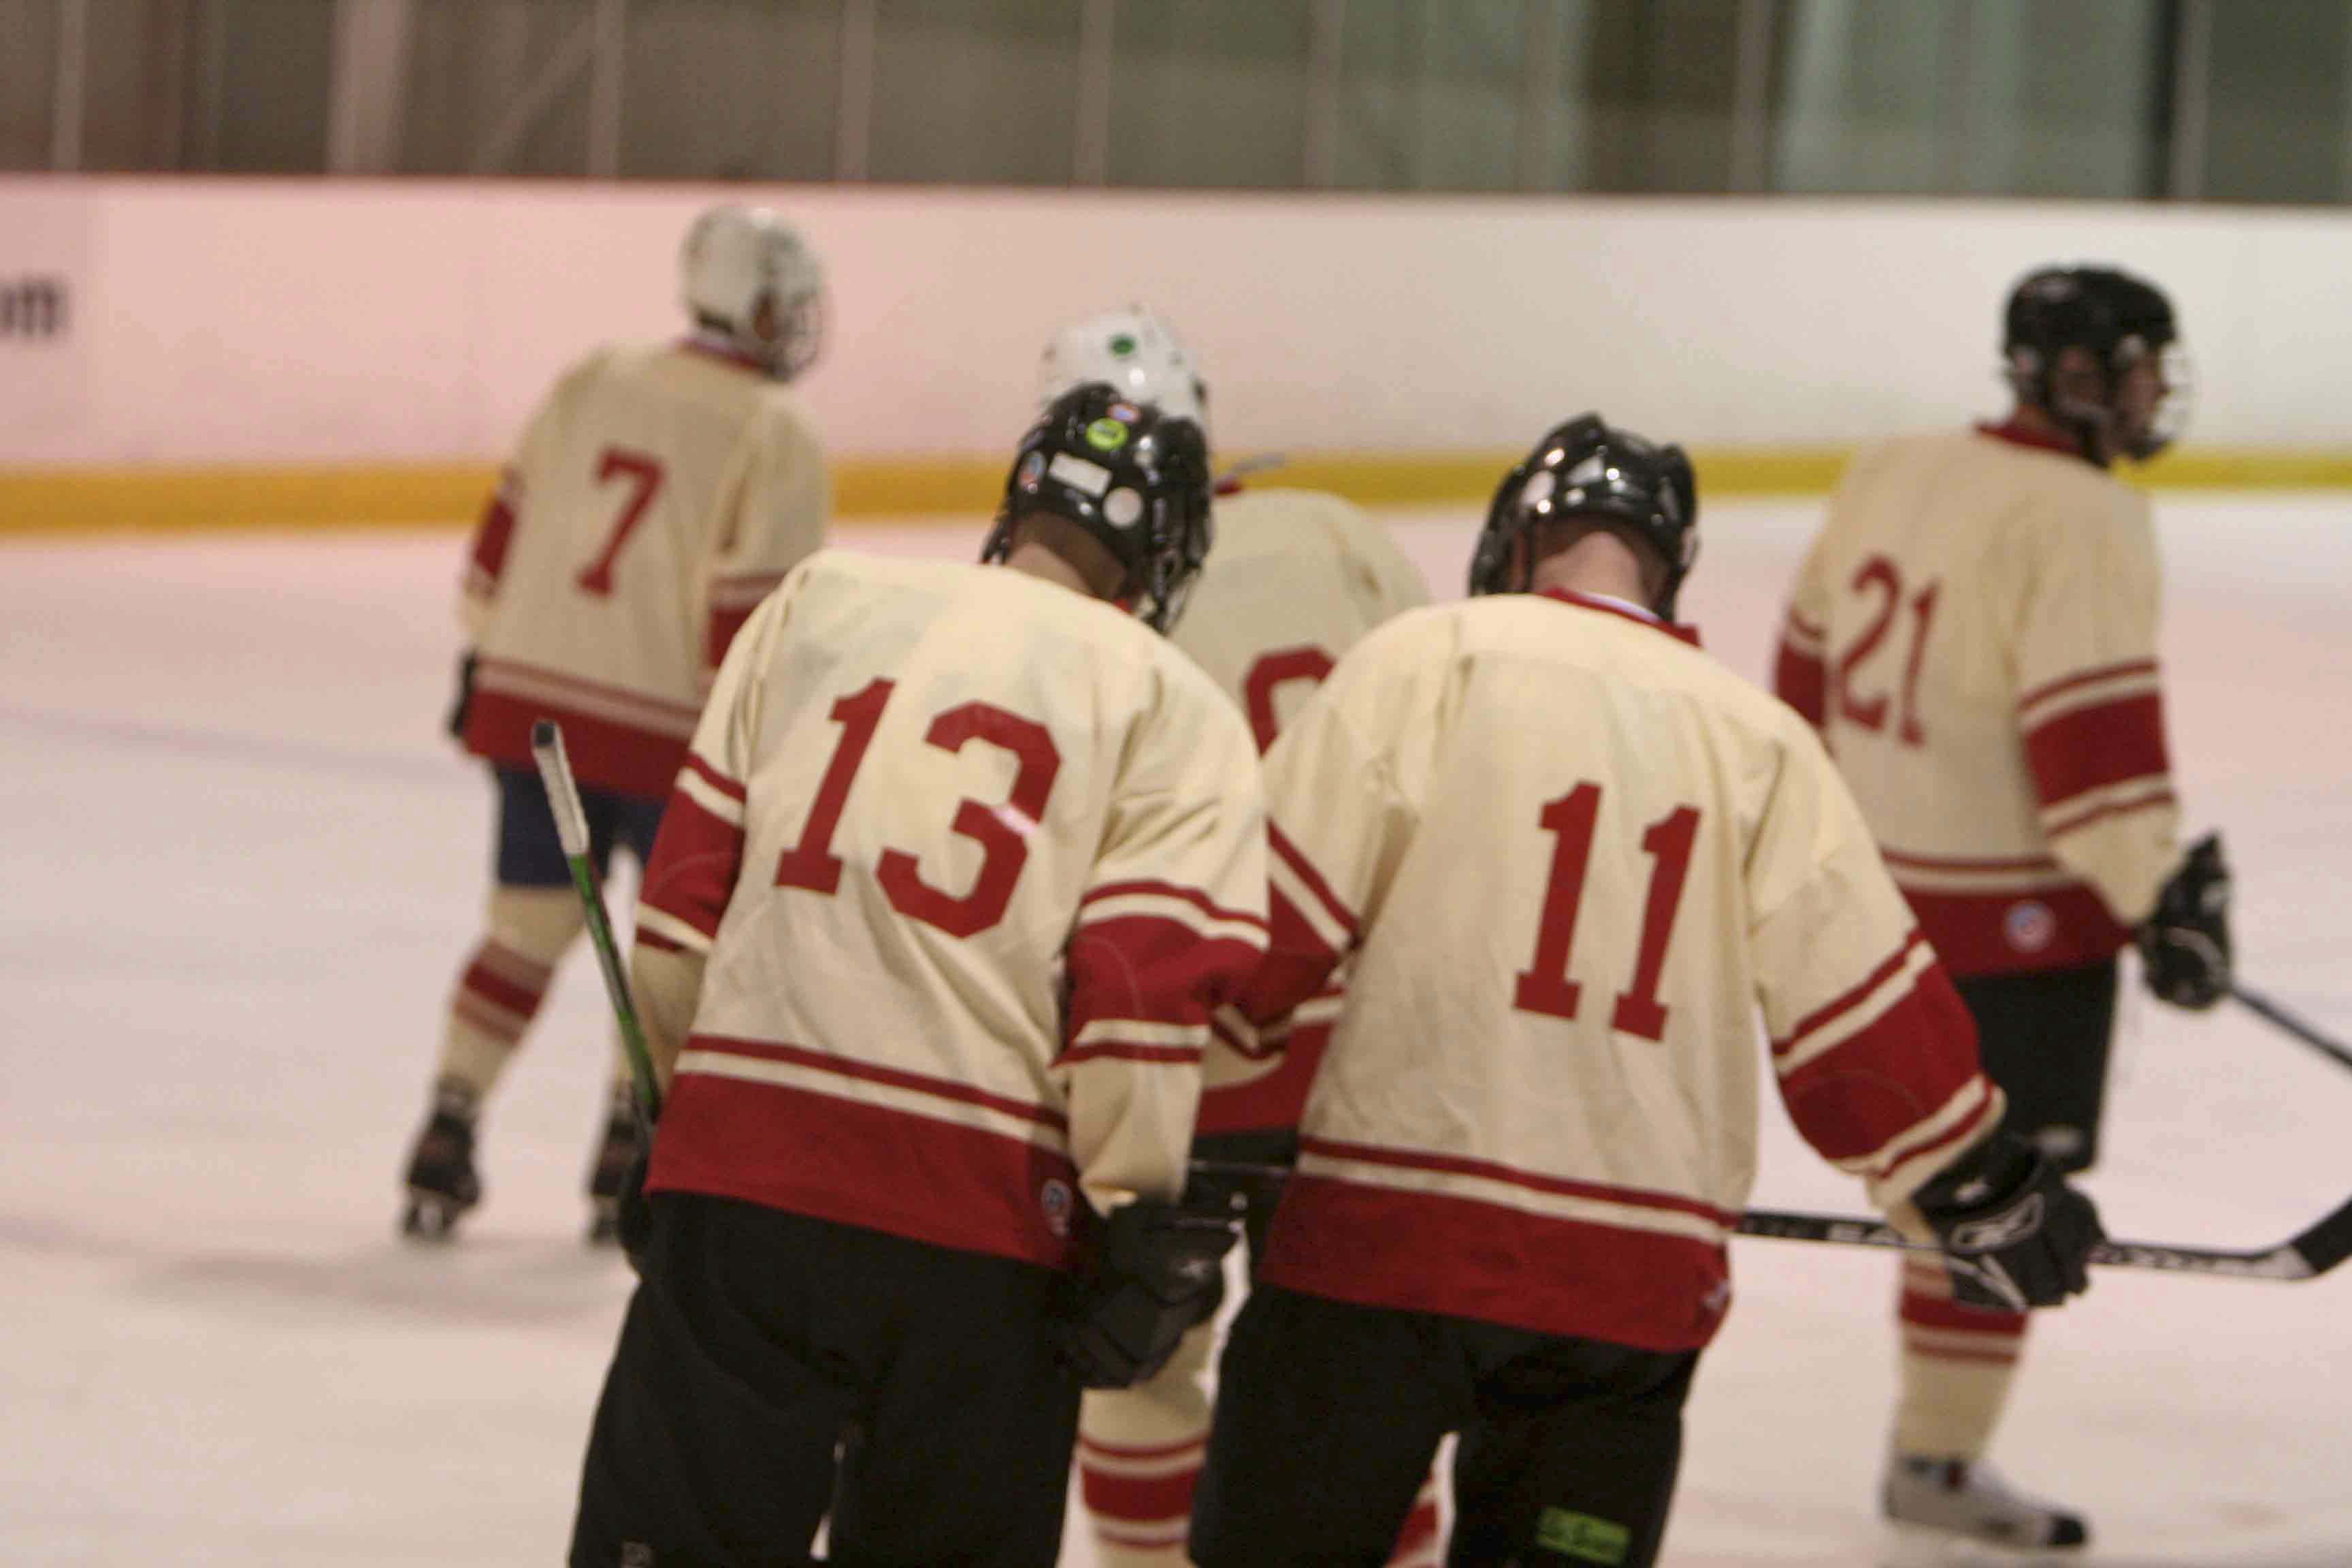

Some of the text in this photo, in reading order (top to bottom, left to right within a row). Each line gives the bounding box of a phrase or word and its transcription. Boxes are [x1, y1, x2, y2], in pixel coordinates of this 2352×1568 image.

[576, 446, 667, 598] 7
[1837, 555, 1940, 749] 21
[775, 677, 1061, 938] 13
[1512, 782, 1701, 1043] 11
